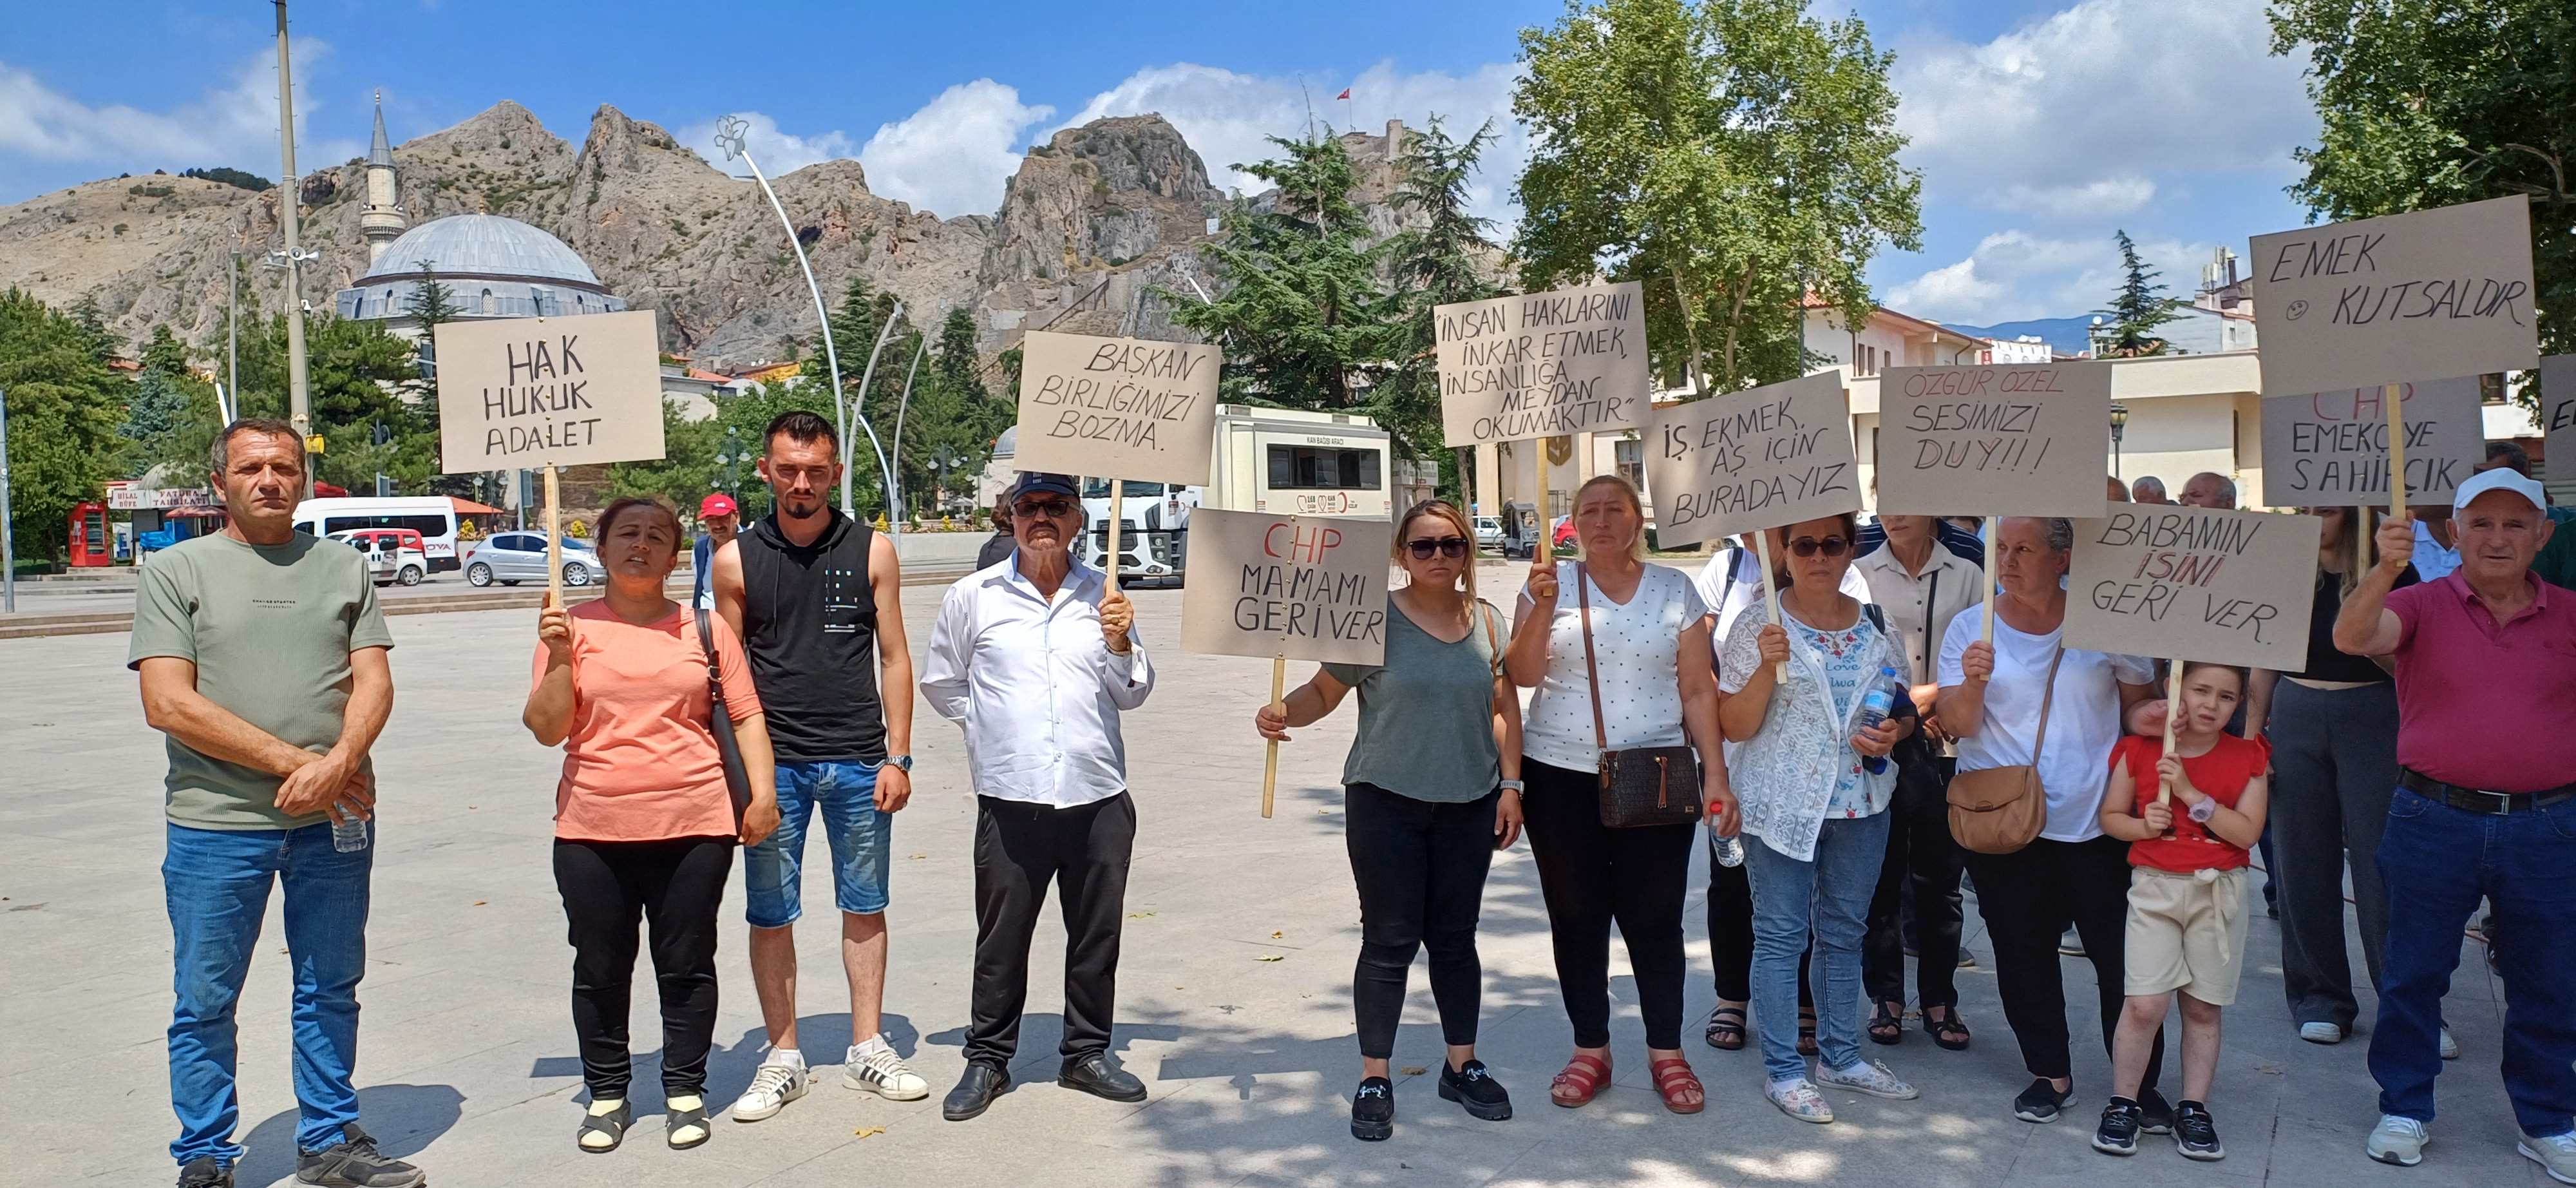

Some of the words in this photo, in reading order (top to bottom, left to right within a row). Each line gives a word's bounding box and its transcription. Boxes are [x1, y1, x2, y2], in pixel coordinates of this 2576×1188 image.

[2270, 233, 2386, 283] EMEK
[1522, 293, 1631, 328] HAKLARINI
[507, 335, 584, 386] HAK
[1084, 343, 1206, 381] BAŞKAN
[1463, 335, 1535, 366] İNKAR
[1542, 327, 1628, 359] ETMEK,
[1446, 359, 1569, 395] İNSANLIĞA
[1501, 376, 1602, 414] MEYDAN
[1904, 368, 1995, 398] ÖZGÜR
[2000, 366, 2064, 393] ÖZEL
[484, 380, 592, 421] HUKUK
[1033, 374, 1200, 422] BİRLİĞİMİZİ
[1906, 400, 2043, 434] SESİMİZİ
[486, 417, 602, 456] ADALET
[1046, 410, 1164, 451] BOZMA.
[1710, 445, 1747, 477] AŞ
[1765, 428, 1830, 465] İÇİN
[1913, 437, 2052, 475] DUY!!!
[1264, 522, 1341, 565] CHP
[2096, 513, 2262, 555] BABAMIN
[1242, 563, 1366, 606] MAMAMI
[2092, 580, 2184, 622] GERİ
[2204, 593, 2278, 645] VER.
[1825, 662, 1862, 671] Love
